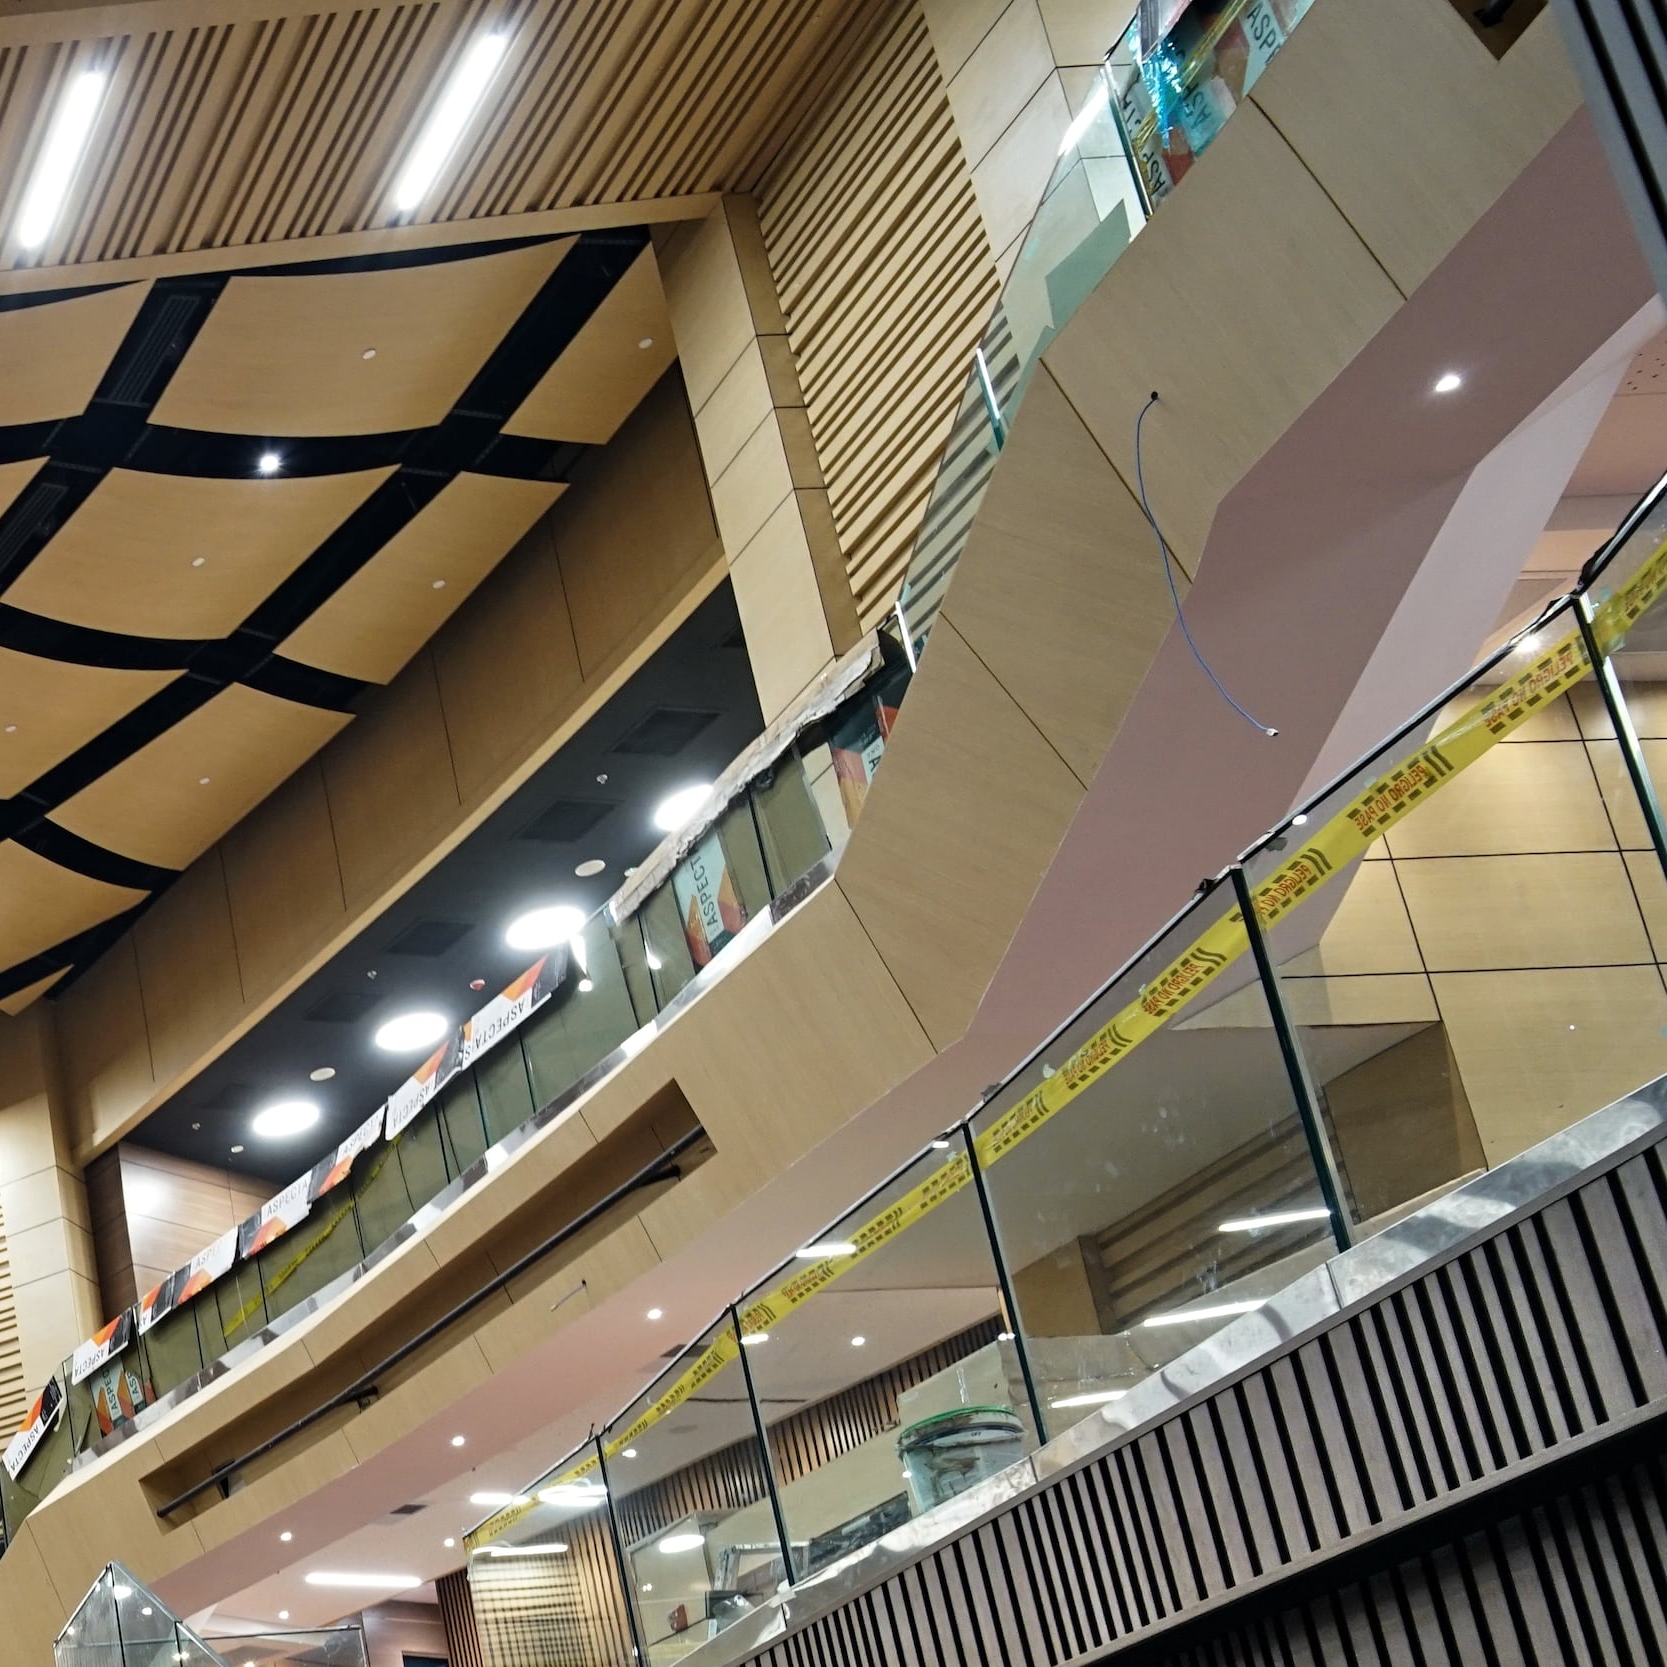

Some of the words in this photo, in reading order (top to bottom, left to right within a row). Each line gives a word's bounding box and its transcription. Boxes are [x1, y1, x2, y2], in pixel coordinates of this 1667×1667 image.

[475, 998, 525, 1049] ASPECTA
[267, 1179, 309, 1216] ASPECTA
[75, 1349, 104, 1378] ASPECTA
[10, 1425, 40, 1471] ASPECTA
